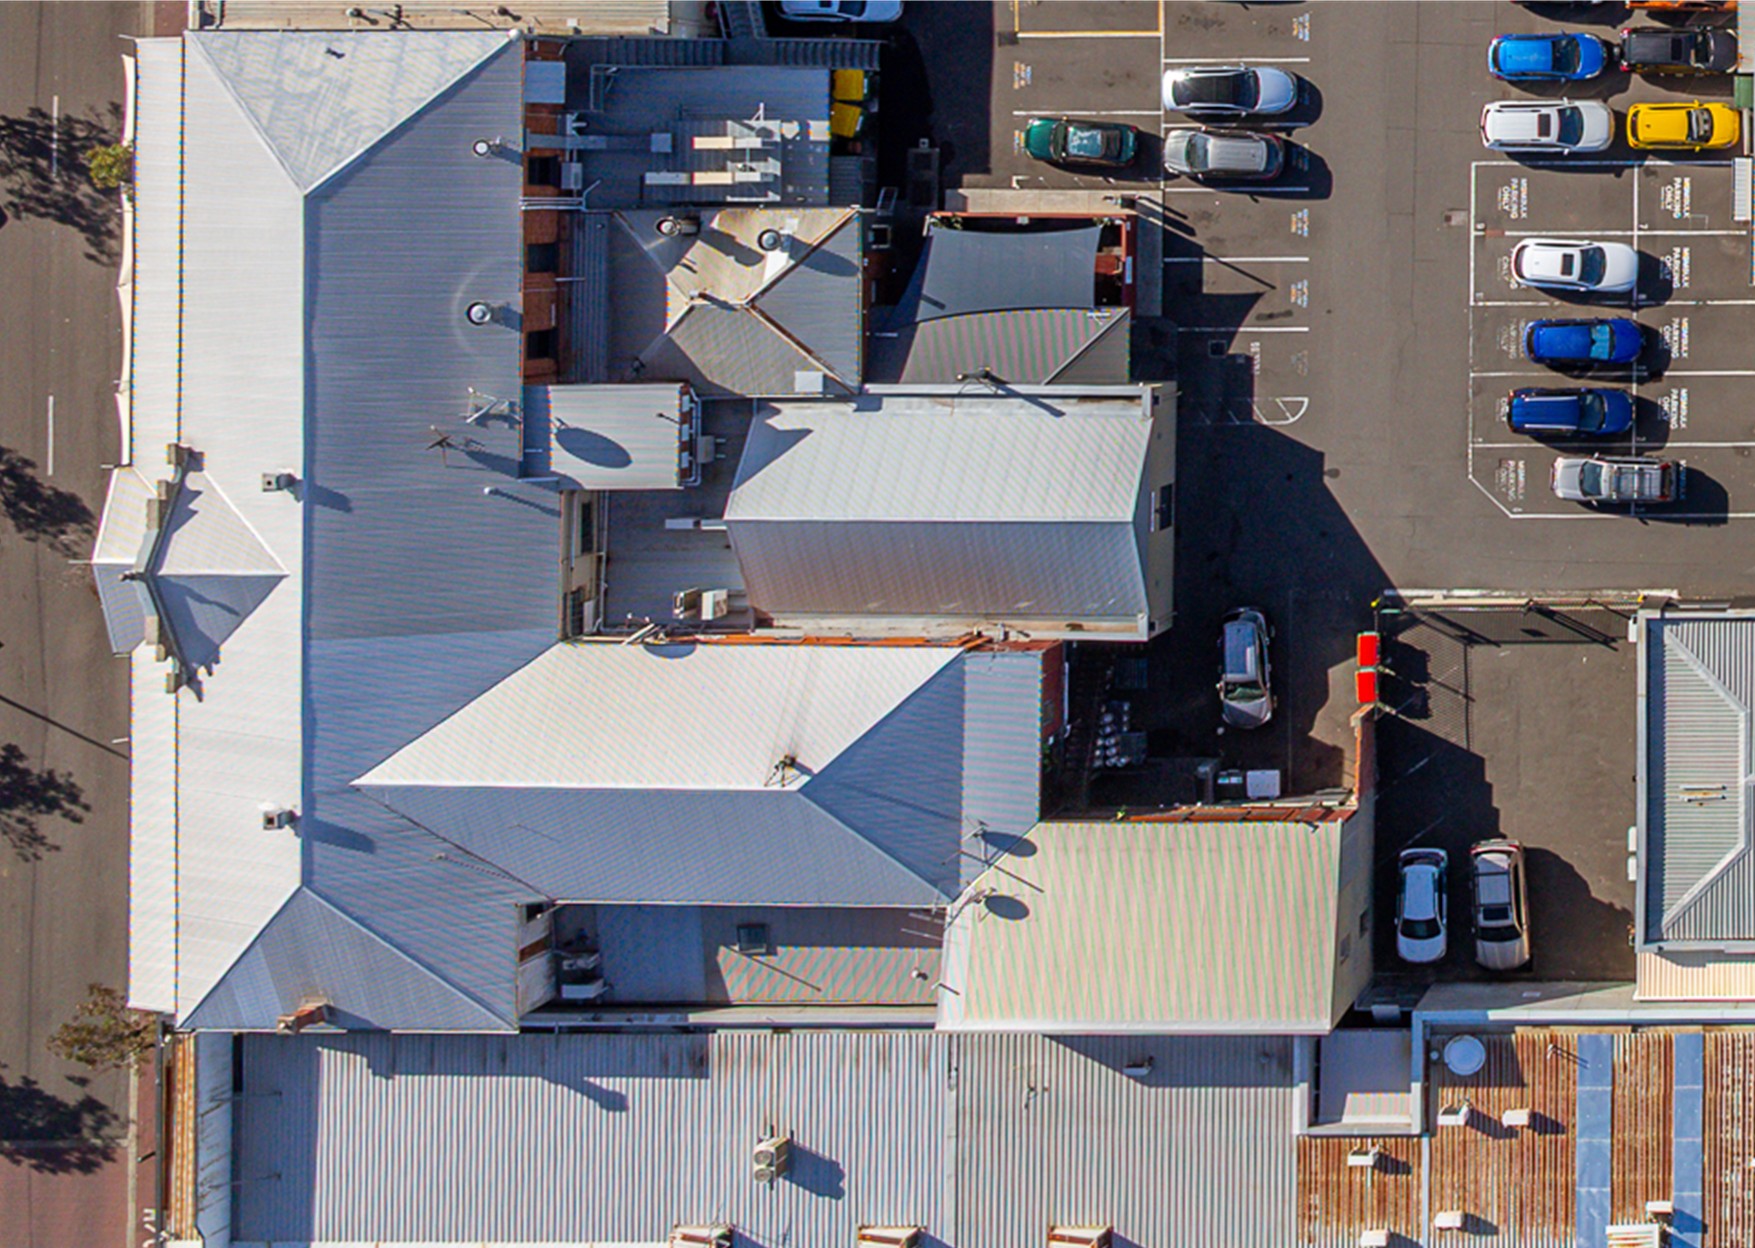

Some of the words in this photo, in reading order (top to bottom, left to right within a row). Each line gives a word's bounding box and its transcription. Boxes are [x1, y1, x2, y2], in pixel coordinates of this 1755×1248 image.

[1502, 186, 1510, 211] ONLY
[1510, 177, 1519, 219] PARKING
[1664, 185, 1673, 209] ONLY
[1673, 176, 1682, 219] PARKING
[1672, 246, 1681, 289] PARKING
[1671, 317, 1680, 359] PARKING
[1670, 388, 1678, 430] PARKING
